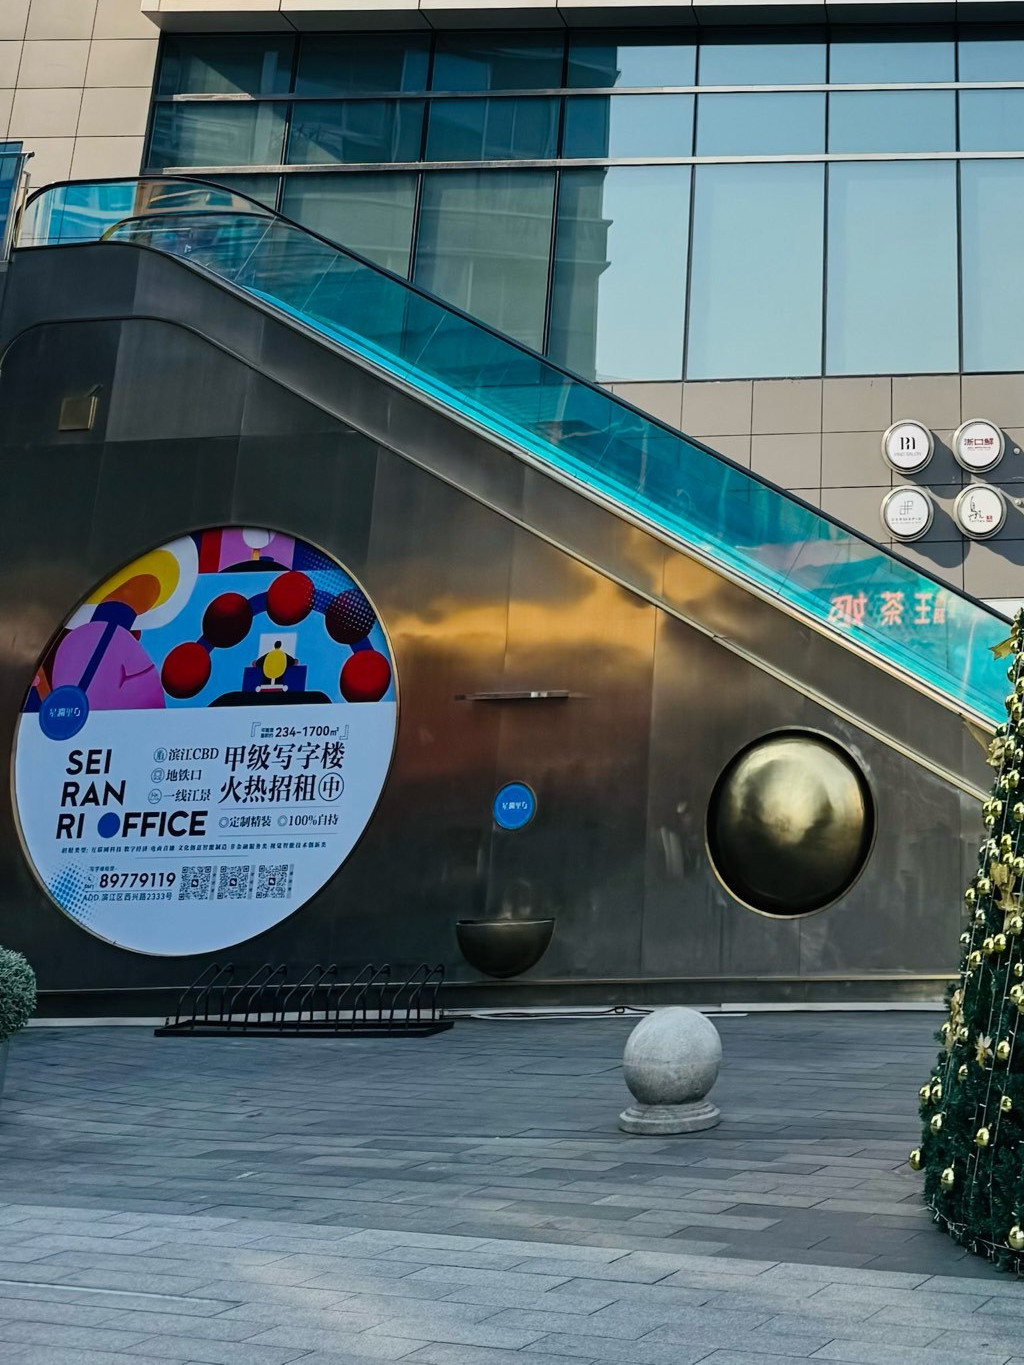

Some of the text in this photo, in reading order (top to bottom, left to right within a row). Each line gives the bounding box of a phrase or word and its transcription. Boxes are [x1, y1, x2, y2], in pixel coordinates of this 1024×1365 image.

[65, 749, 112, 775] SEI
[168, 747, 219, 762] 滨江CBD
[224, 741, 345, 772] 甲级写字楼
[166, 769, 202, 782] 地铁口
[60, 780, 126, 807] RAN
[164, 788, 212, 803] 一线江景
[56, 813, 85, 839] RI
[229, 813, 339, 828] 定制精装 100%自持
[100, 872, 176, 888] 89779119
